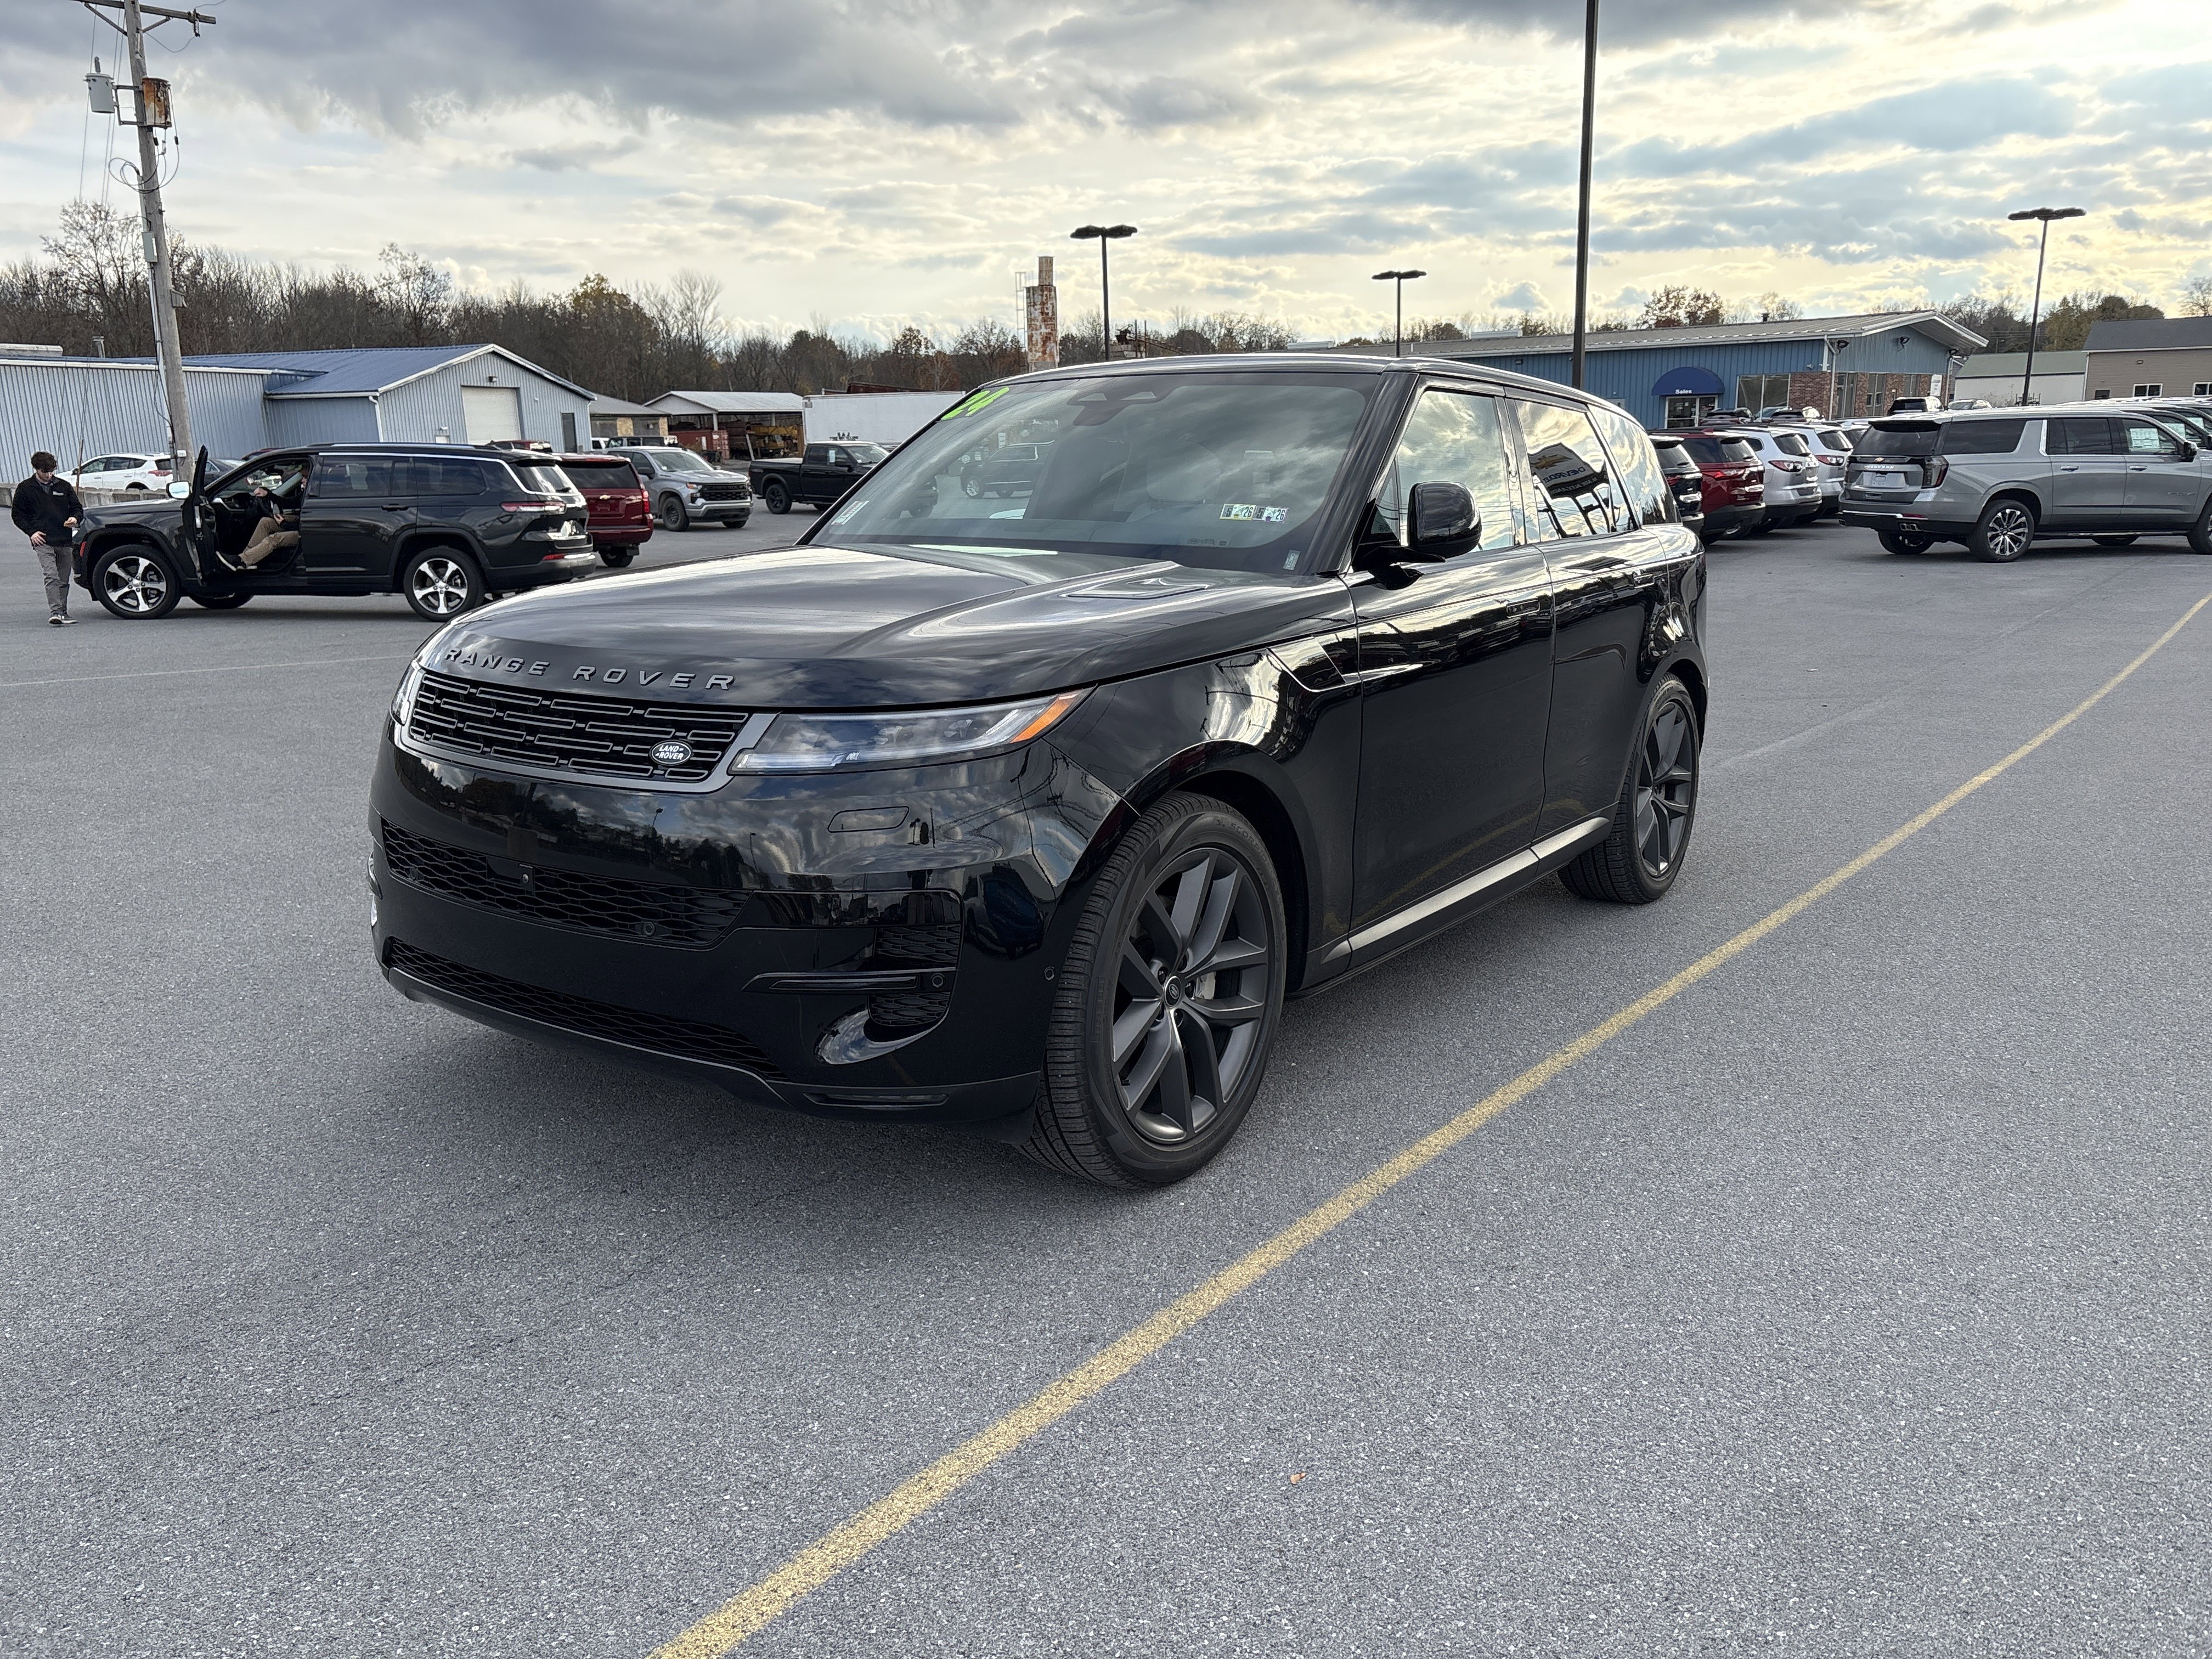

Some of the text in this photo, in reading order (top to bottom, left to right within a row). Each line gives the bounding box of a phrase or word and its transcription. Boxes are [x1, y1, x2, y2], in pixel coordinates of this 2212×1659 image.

[1226, 507, 1254, 517] 5 26
[1256, 508, 1285, 520] 5 26
[444, 649, 736, 691] RANGE ROVER
